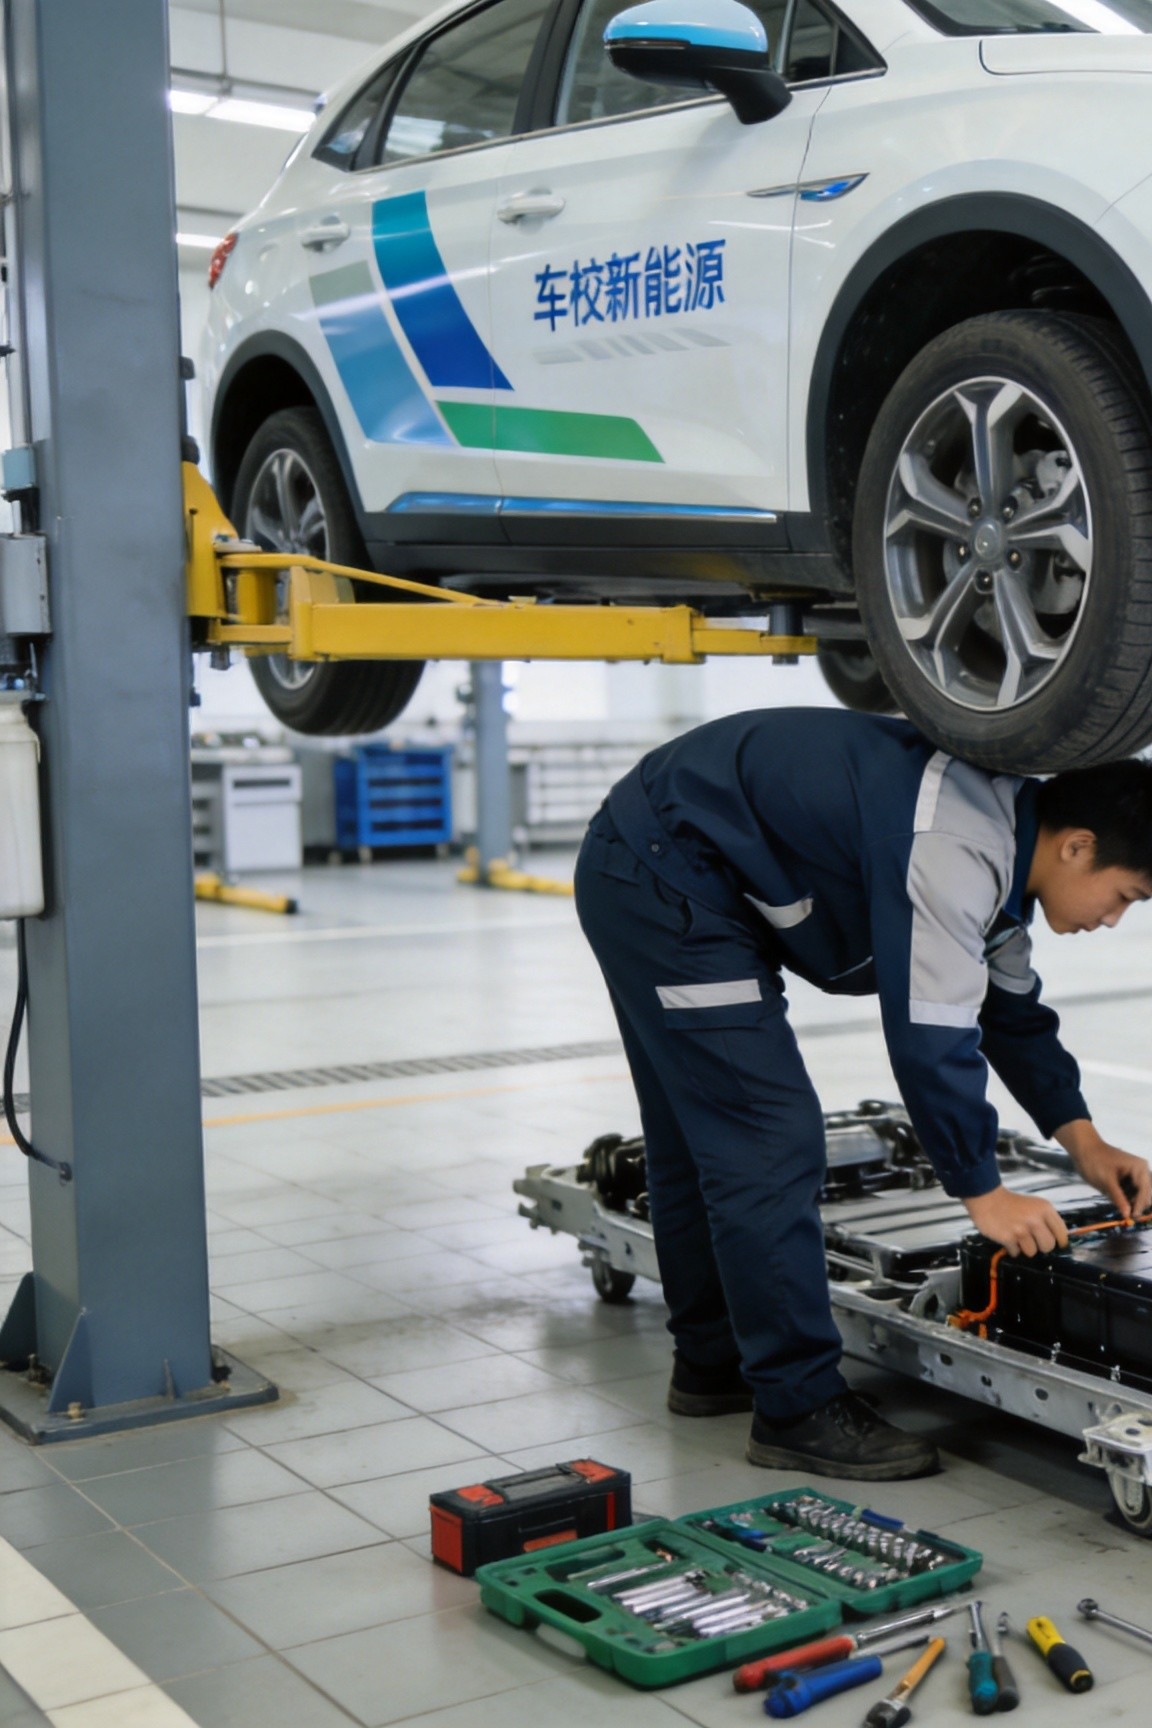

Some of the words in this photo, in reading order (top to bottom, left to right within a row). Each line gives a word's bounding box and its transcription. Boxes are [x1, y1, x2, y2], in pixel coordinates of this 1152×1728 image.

[533, 239, 726, 332] 车校新能源
